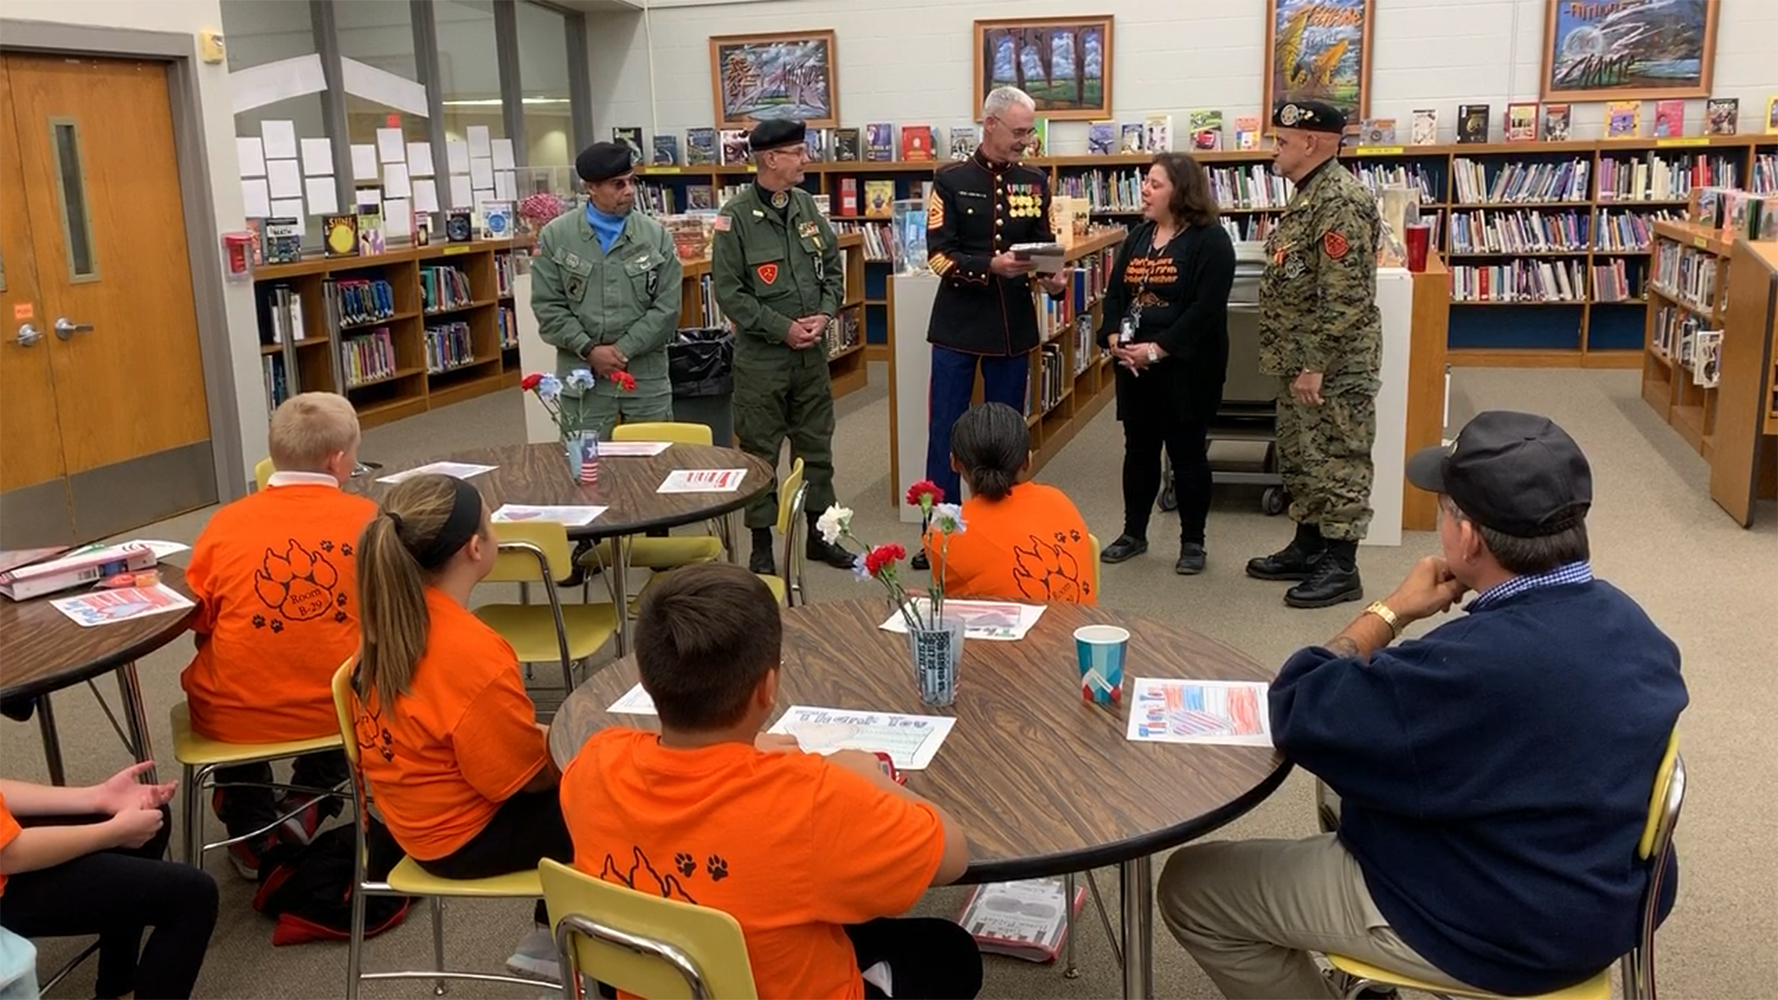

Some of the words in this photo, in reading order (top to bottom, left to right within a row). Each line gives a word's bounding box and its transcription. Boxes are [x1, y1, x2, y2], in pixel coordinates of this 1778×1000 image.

[290, 588, 321, 605] Room
[299, 600, 323, 616] B-29
[795, 710, 880, 726] Thank
